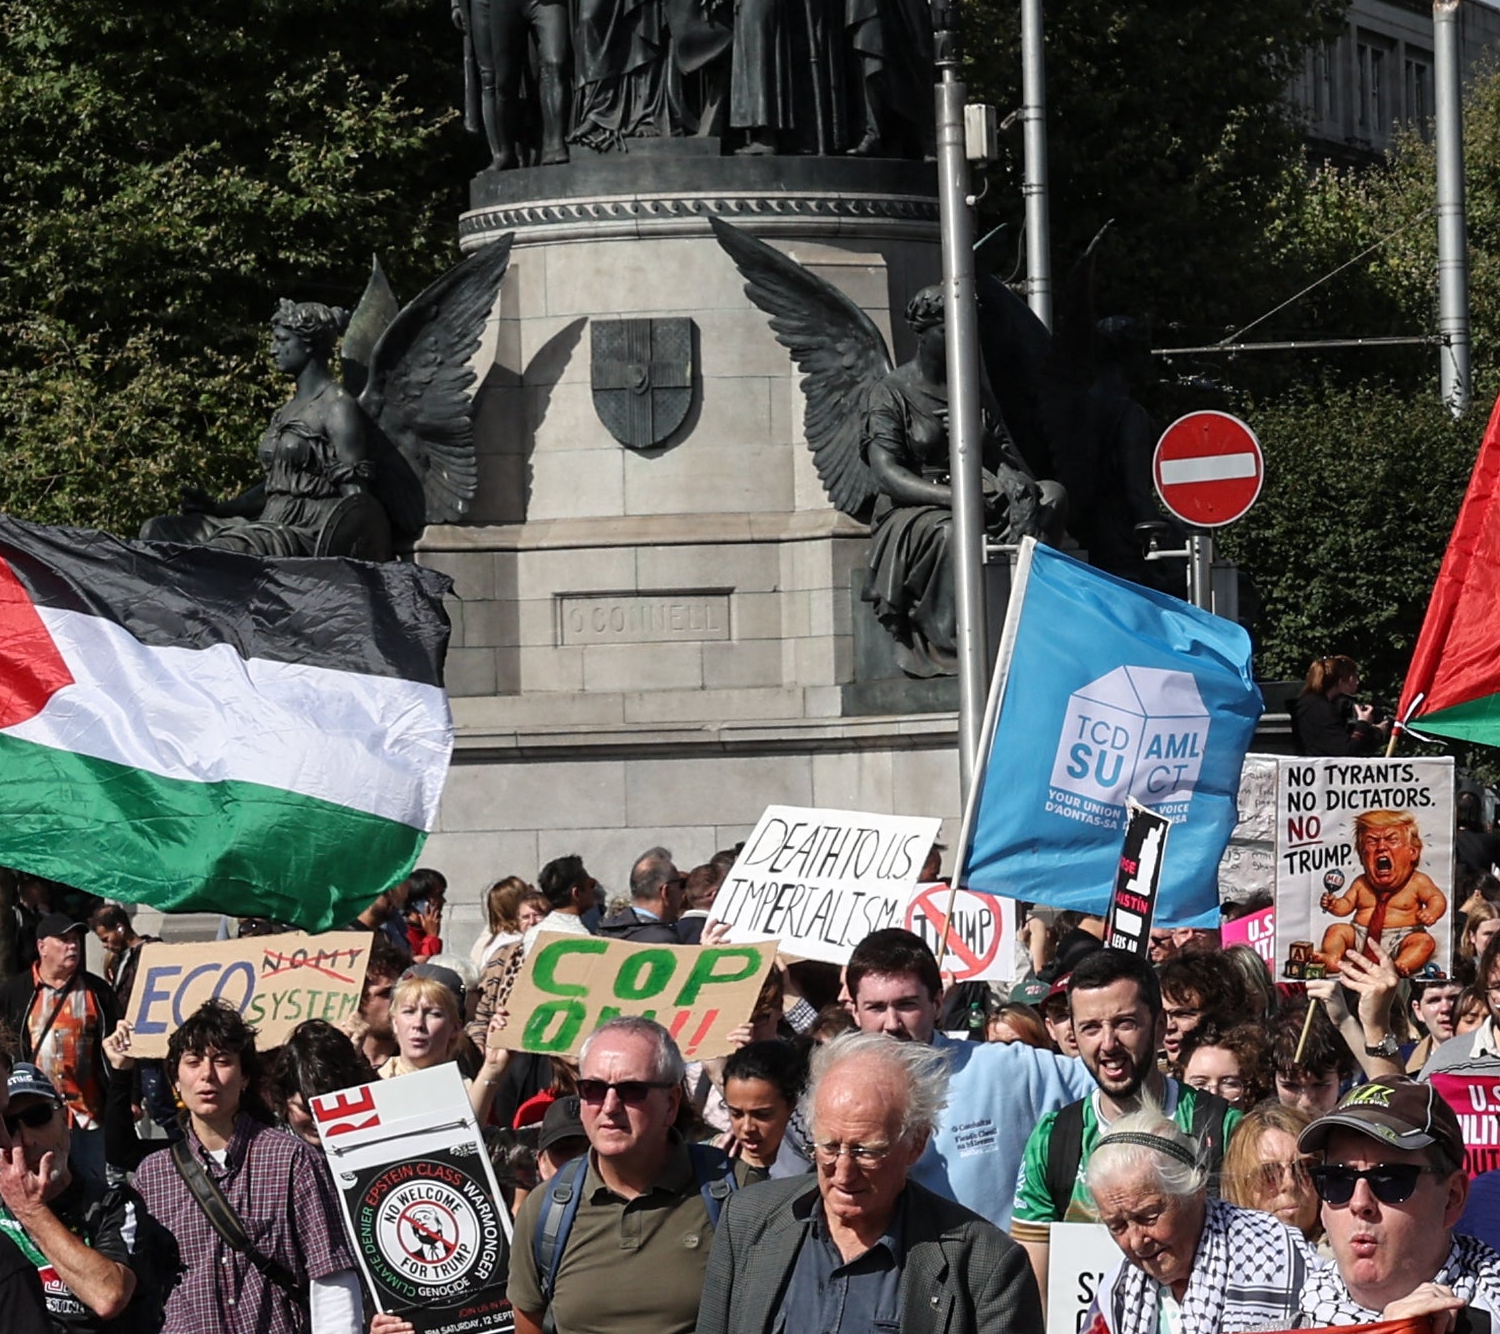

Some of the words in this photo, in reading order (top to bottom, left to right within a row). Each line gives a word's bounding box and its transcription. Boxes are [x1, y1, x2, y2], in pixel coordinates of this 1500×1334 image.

[1078, 714, 1129, 751] TCD
[1143, 732, 1200, 760] AML
[1066, 742, 1124, 788] SU
[1147, 764, 1189, 794] CT
[1287, 766, 1316, 788] NO
[1324, 763, 1420, 785] TYRANTS.
[1048, 788, 1081, 808] YOUR
[1083, 801, 1121, 819] UNION
[1159, 802, 1189, 814] VOICE
[1287, 791, 1317, 812] NO
[1326, 786, 1436, 811] DICTATORS.
[1287, 815, 1321, 843] NO
[743, 817, 852, 880] DEATH
[854, 827, 880, 880] TO
[1283, 843, 1353, 875] TRUMP.
[262, 948, 362, 973] NOMY
[531, 938, 763, 1007] COP
[134, 961, 256, 1035] ECO
[248, 988, 359, 1025] SYSTEM
[365, 1164, 414, 1206] EPSTEIN
[416, 1162, 462, 1186] CLASS
[383, 1205, 398, 1224] NO
[400, 1186, 463, 1215] WELCOME
[361, 1207, 376, 1253] DENIER
[462, 1180, 498, 1280] WARMONGER
[369, 1251, 417, 1298] CLIMATE
[401, 1257, 428, 1277] FOR
[431, 1243, 472, 1279] TRUMP
[417, 1276, 472, 1297] GENOCIDE
[482, 1316, 492, 1325] 12
